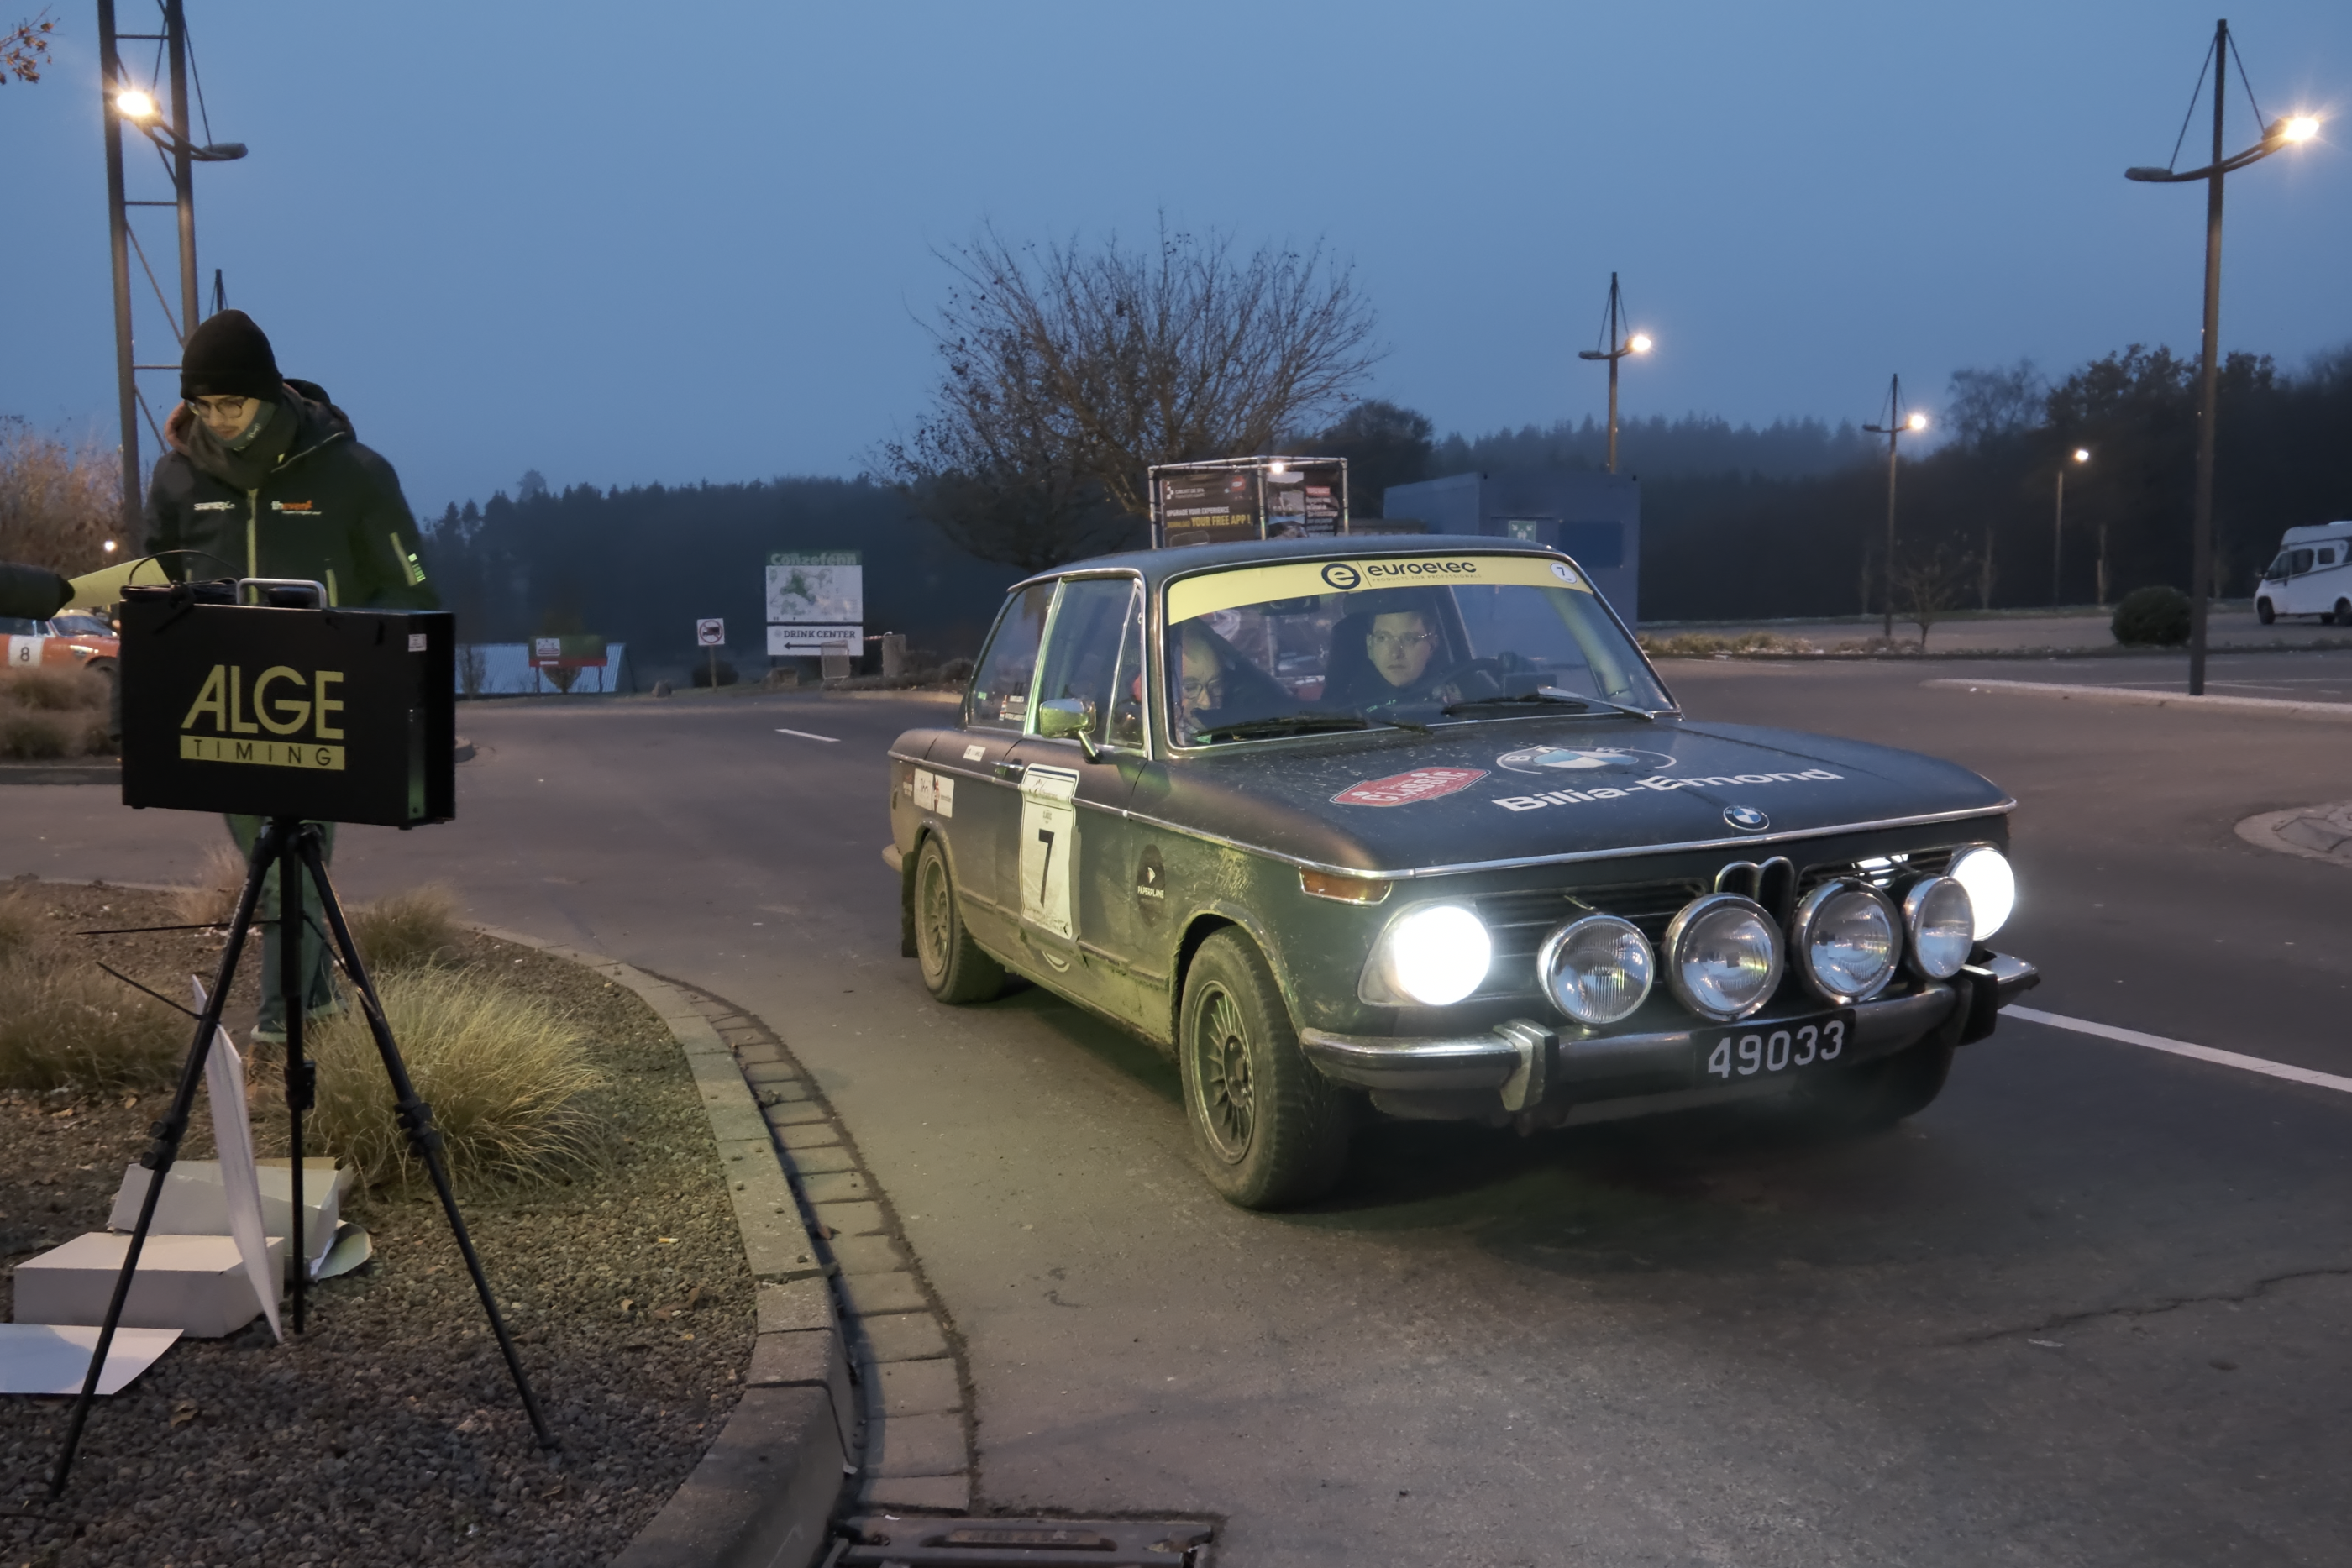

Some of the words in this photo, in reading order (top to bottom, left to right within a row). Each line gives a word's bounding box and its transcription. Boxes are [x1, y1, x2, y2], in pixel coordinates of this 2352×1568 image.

[1191, 517, 1210, 527] YOUR
[1211, 515, 1230, 526] FREE
[1231, 514, 1246, 525] APP
[1367, 562, 1477, 576] euroelec
[1557, 566, 1565, 577] 7
[784, 630, 815, 638] DRINK
[816, 630, 856, 638] CENTER
[20, 647, 30, 662] 8
[181, 664, 344, 739] ALGE
[194, 739, 331, 766] TIMING
[1362, 771, 1469, 801] CLASSIC
[1491, 768, 1845, 811] Bilia-Emond
[1038, 828, 1055, 908] 7
[1137, 885, 1164, 899] PAPERPLANE
[1708, 1020, 1845, 1078] 49033
